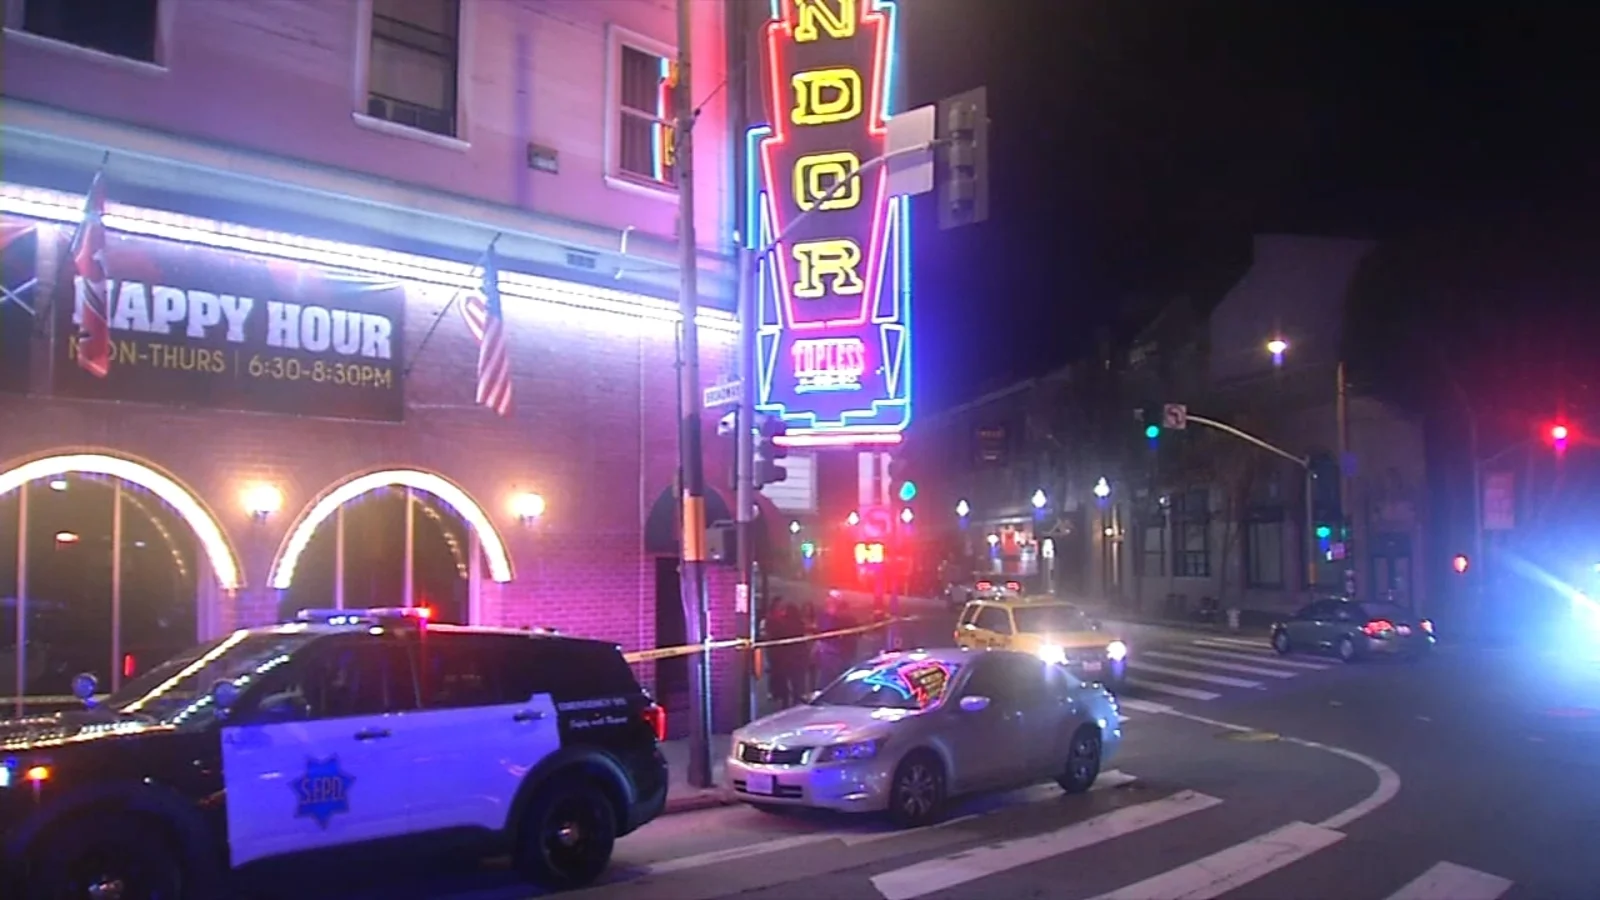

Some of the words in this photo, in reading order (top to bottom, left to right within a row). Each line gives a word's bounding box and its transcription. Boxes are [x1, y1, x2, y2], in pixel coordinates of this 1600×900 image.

[266, 300, 392, 359] HOUR
[248, 354, 393, 389] 6:30-8:30PM
[791, 338, 865, 377] TOPLESS
